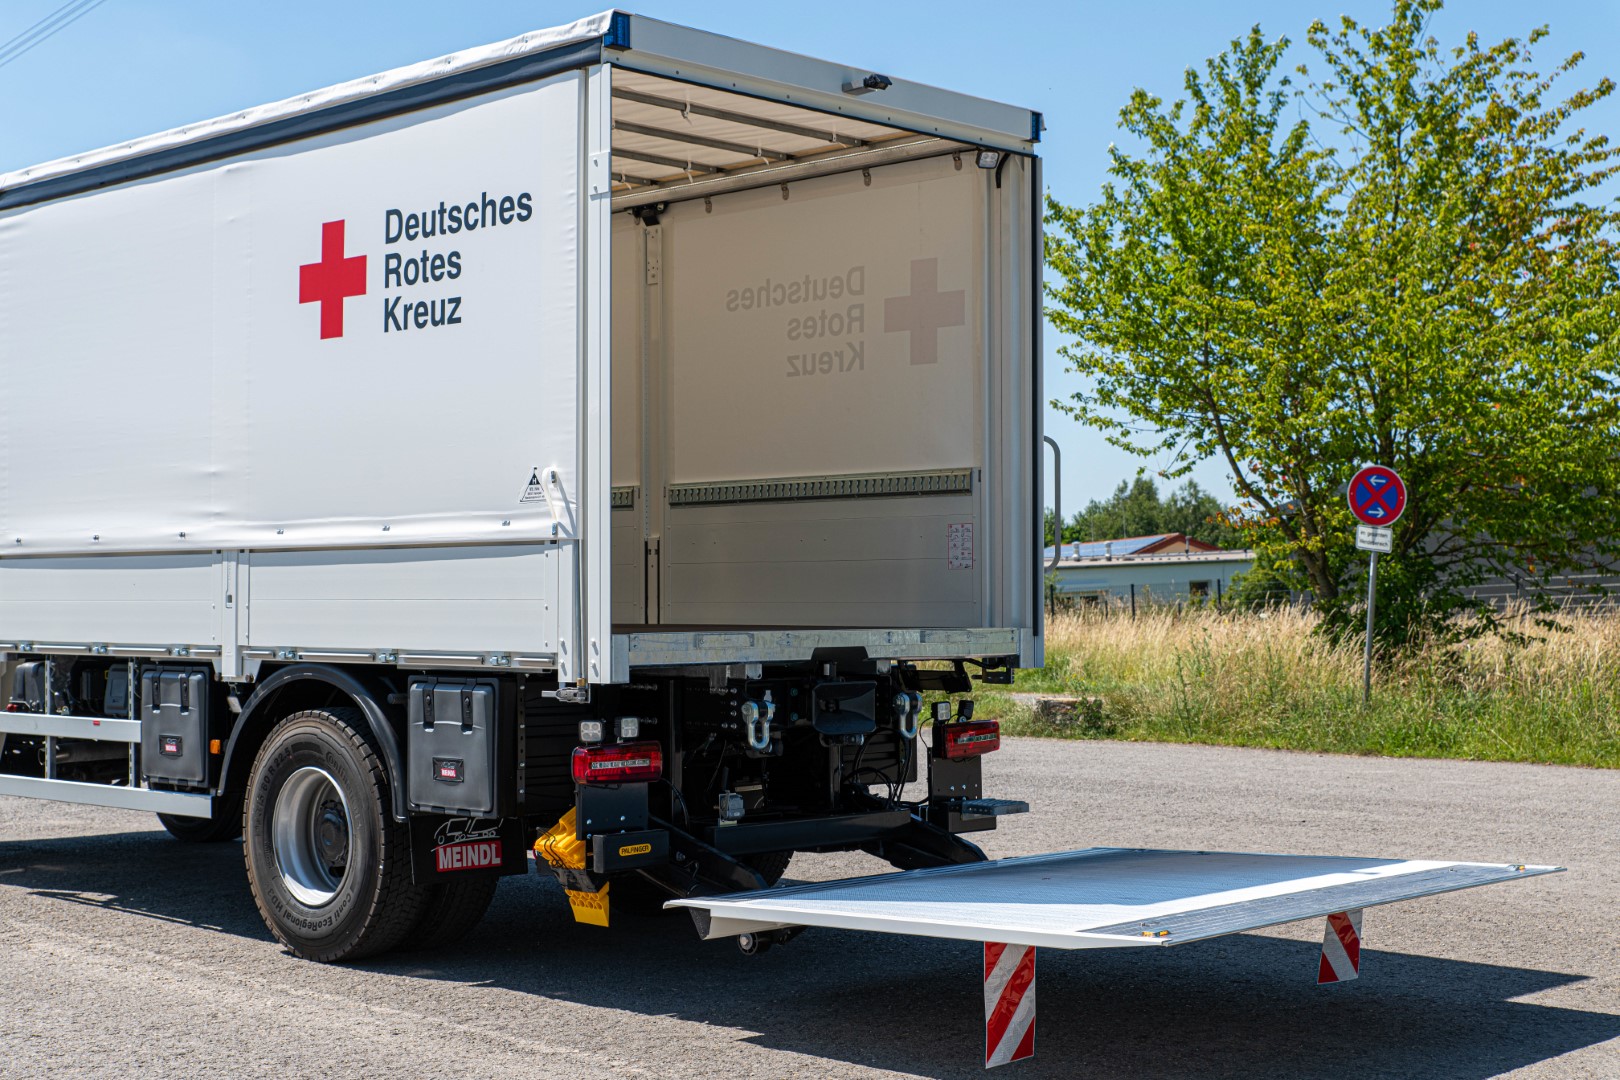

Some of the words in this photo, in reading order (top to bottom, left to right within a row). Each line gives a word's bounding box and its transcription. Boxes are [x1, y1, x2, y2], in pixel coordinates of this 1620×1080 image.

[385, 191, 533, 245] Deutsches
[384, 249, 462, 289] Rotes
[384, 296, 462, 333] Kreuz
[438, 843, 501, 870] MEINDL
[267, 888, 284, 912] HD3
[334, 892, 352, 921] Conti
[283, 909, 333, 931] EcoRegional
